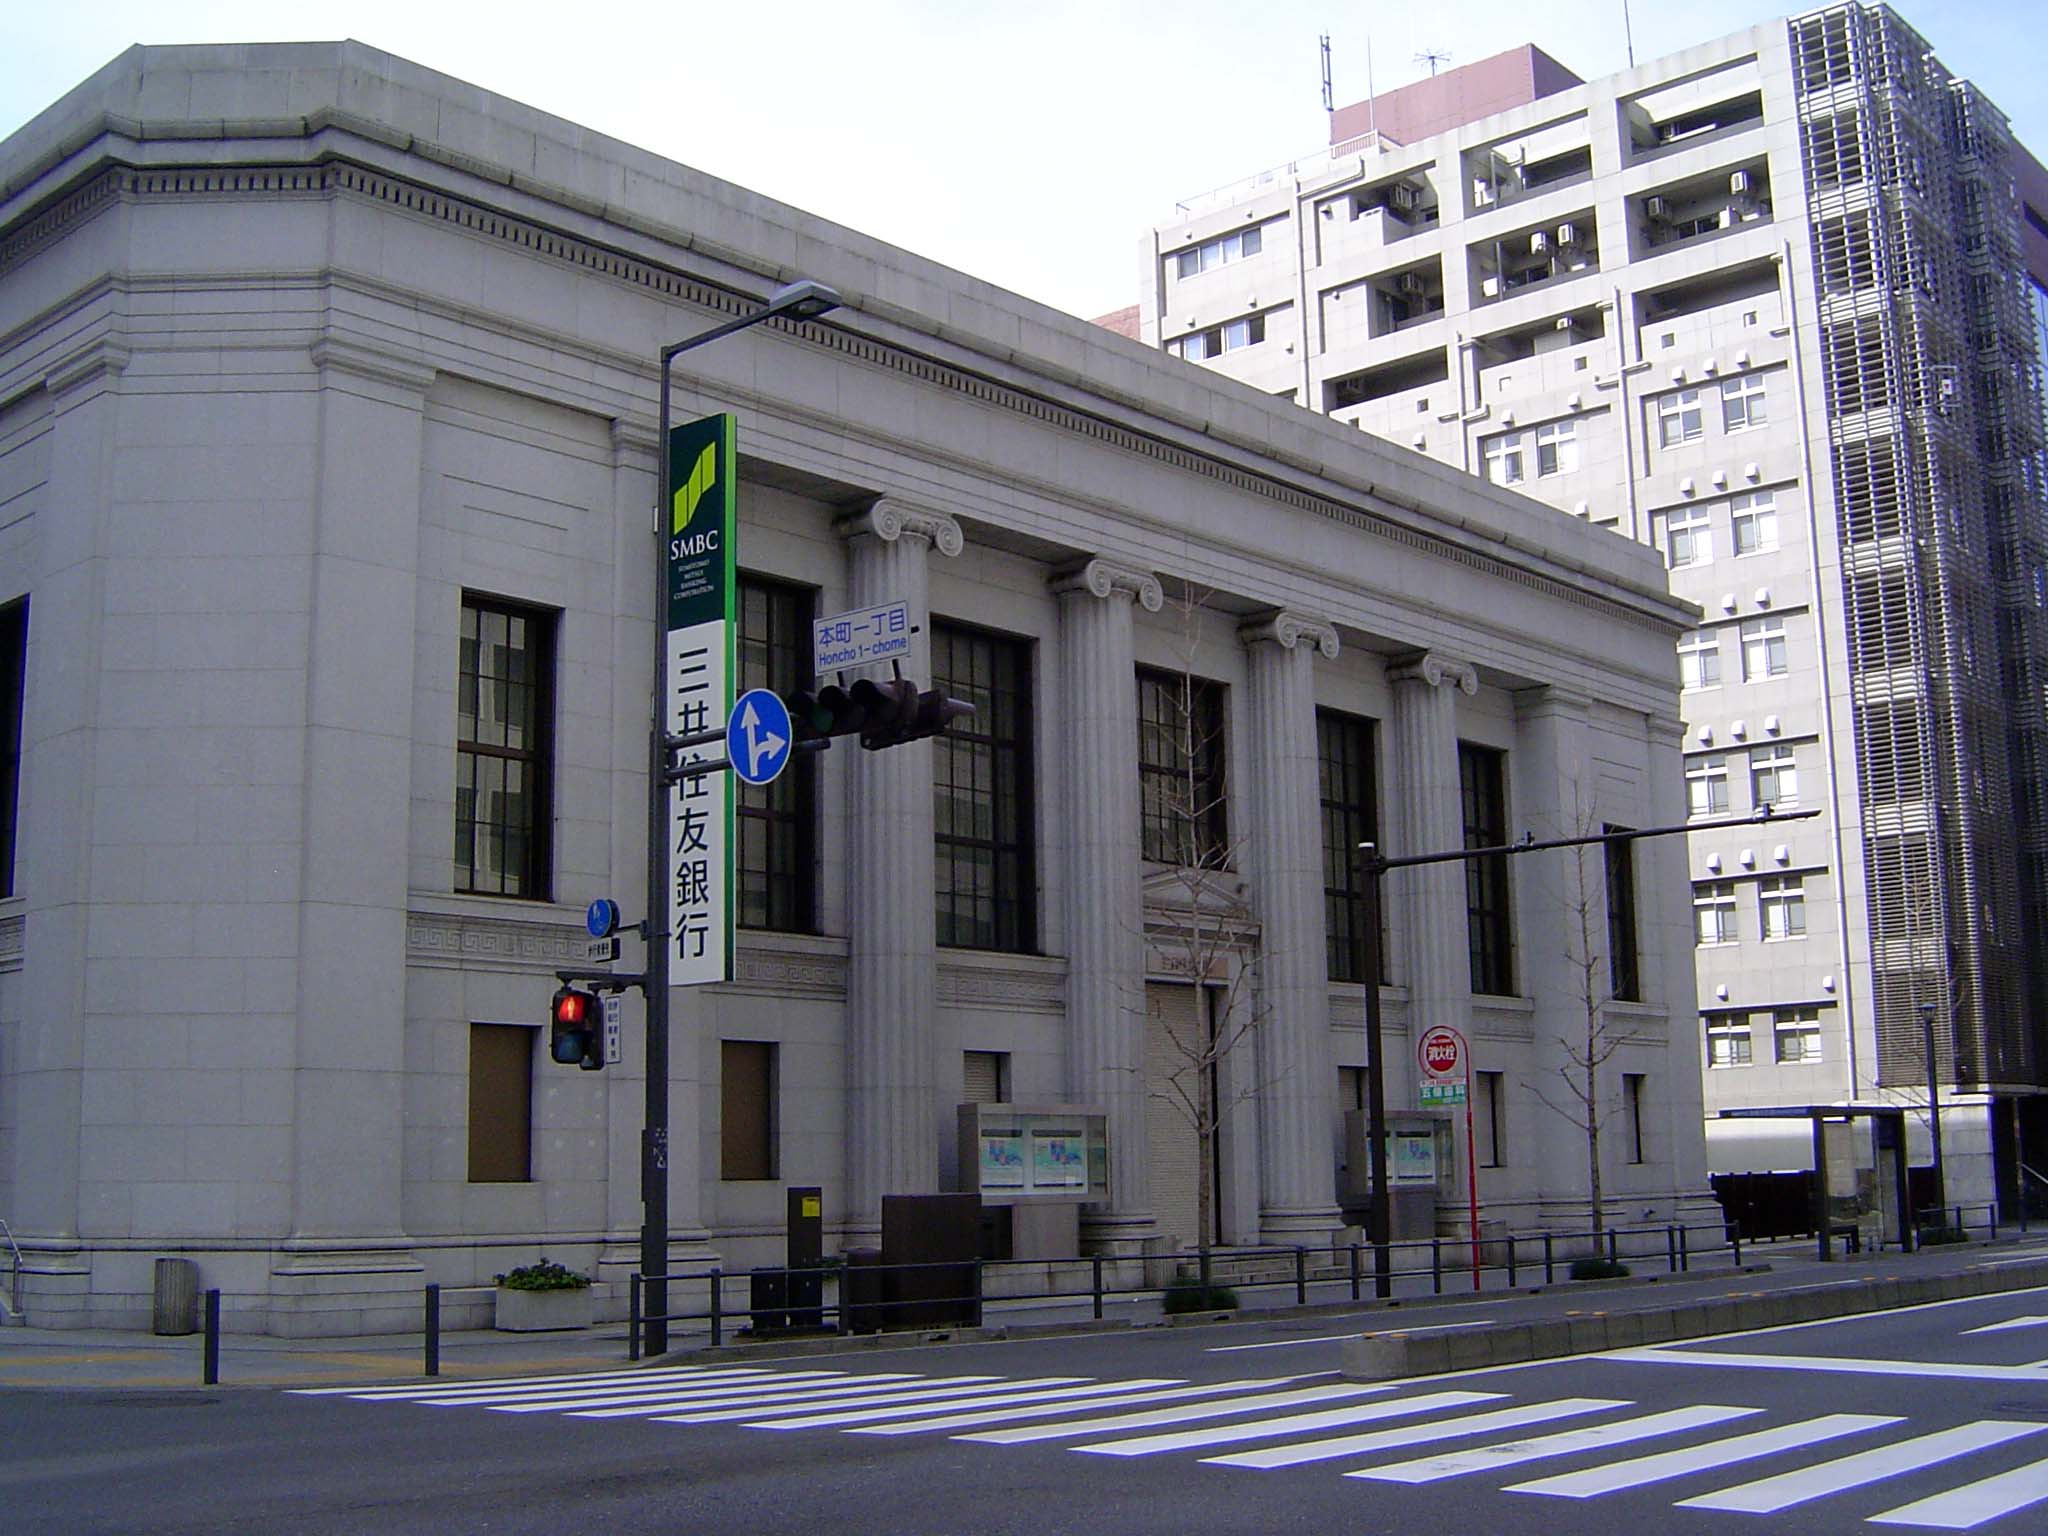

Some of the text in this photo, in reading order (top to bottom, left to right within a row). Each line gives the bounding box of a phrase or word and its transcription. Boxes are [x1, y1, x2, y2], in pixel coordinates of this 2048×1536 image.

[670, 529, 719, 561] SMBC
[817, 608, 905, 648] 本町一丁目
[818, 647, 857, 667] Honcho
[674, 647, 710, 960] 三井住友銀行
